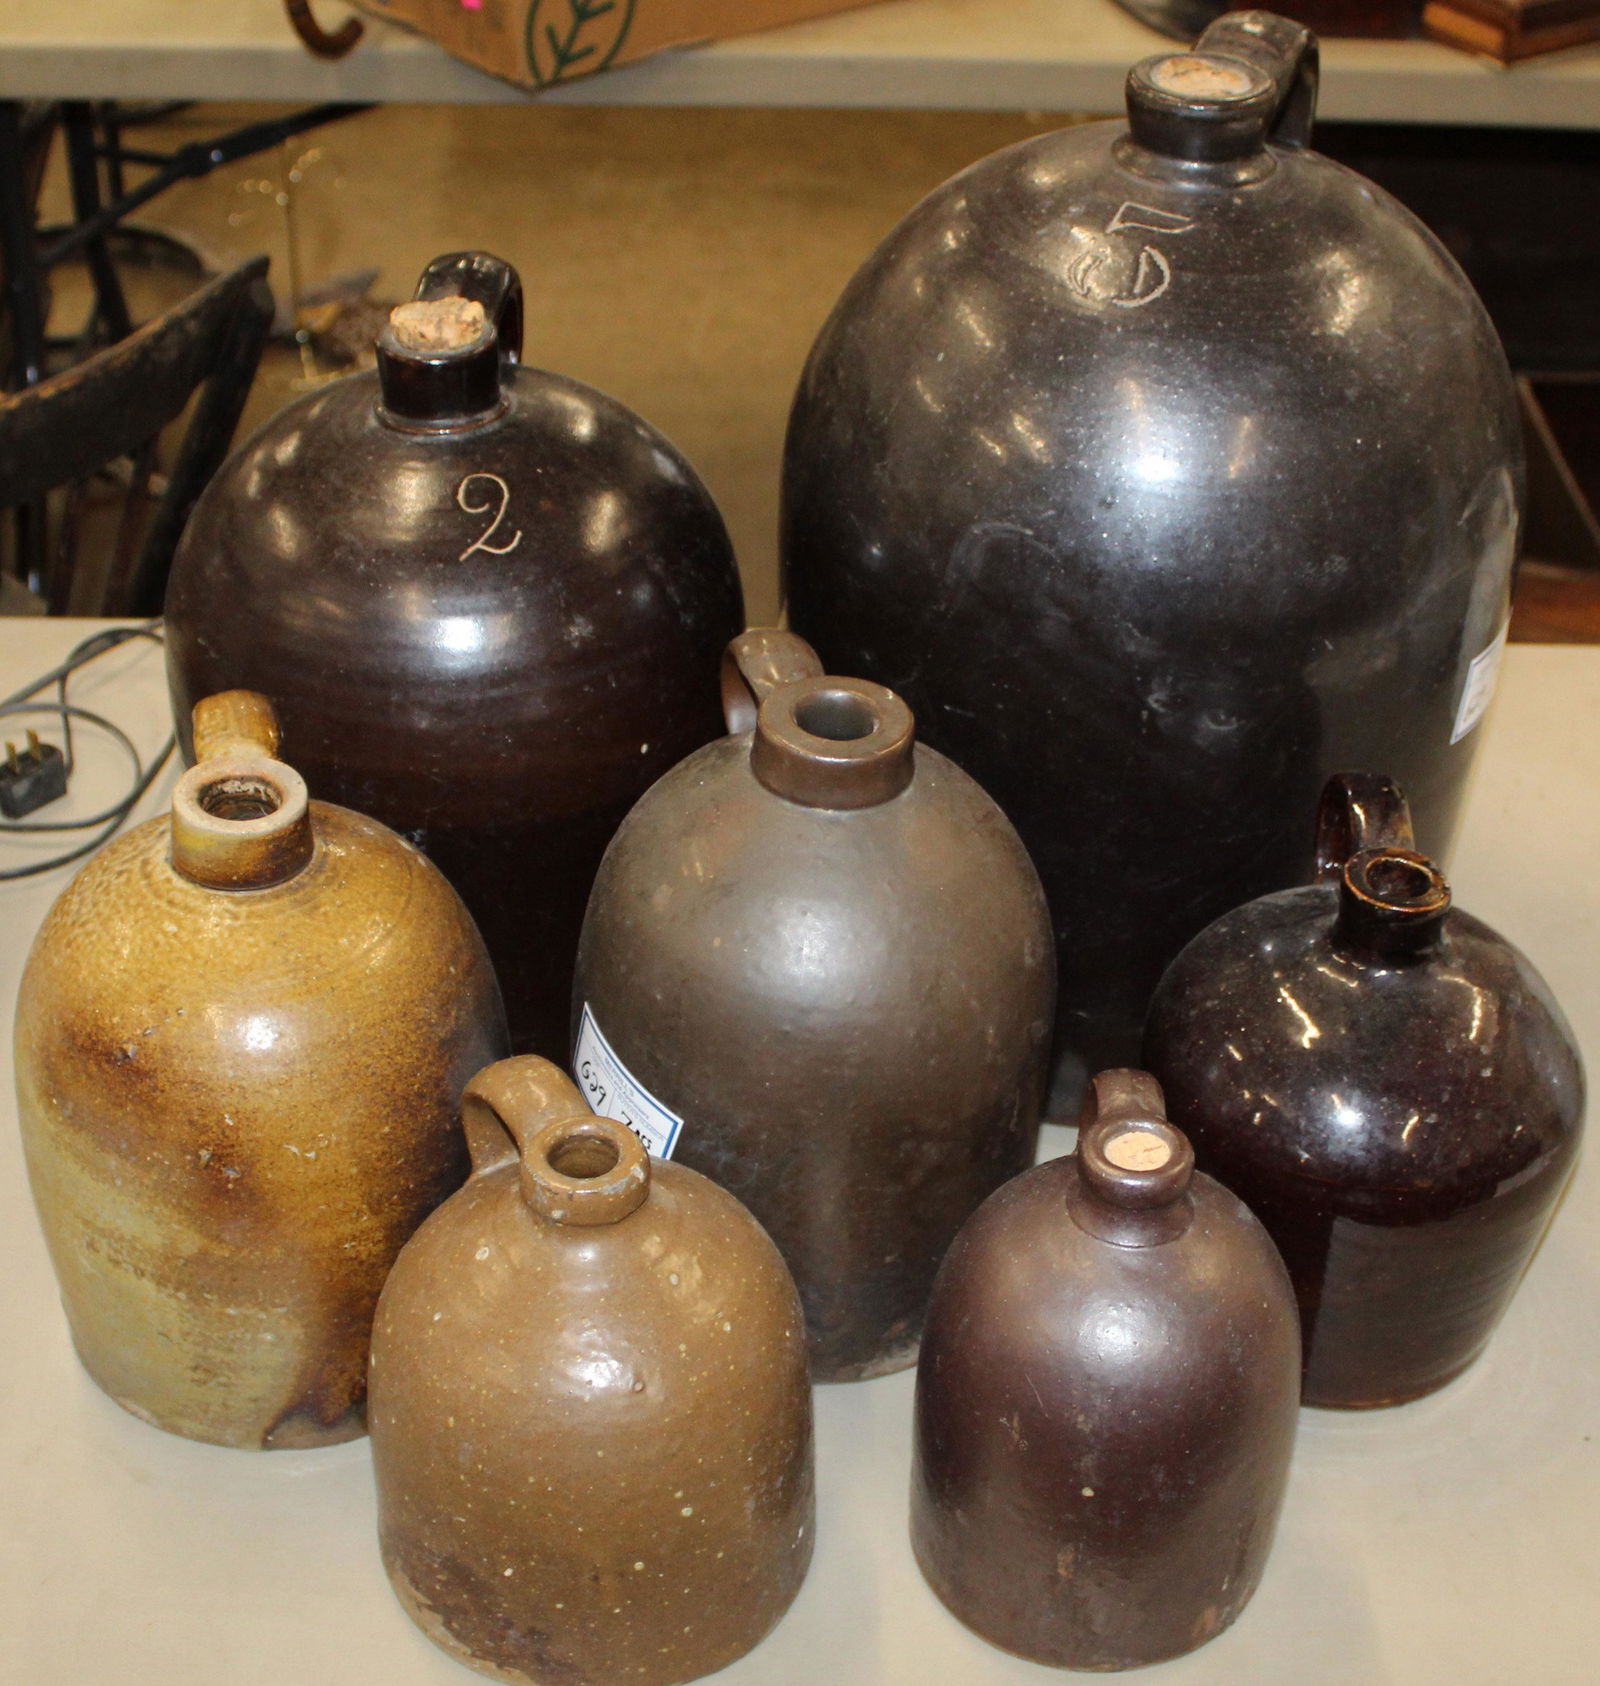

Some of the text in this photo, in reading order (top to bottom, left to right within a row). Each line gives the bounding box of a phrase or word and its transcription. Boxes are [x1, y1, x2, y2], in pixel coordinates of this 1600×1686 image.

[1066, 201, 1195, 308] 5
[457, 473, 522, 562] 2
[581, 1061, 606, 1106] 629
